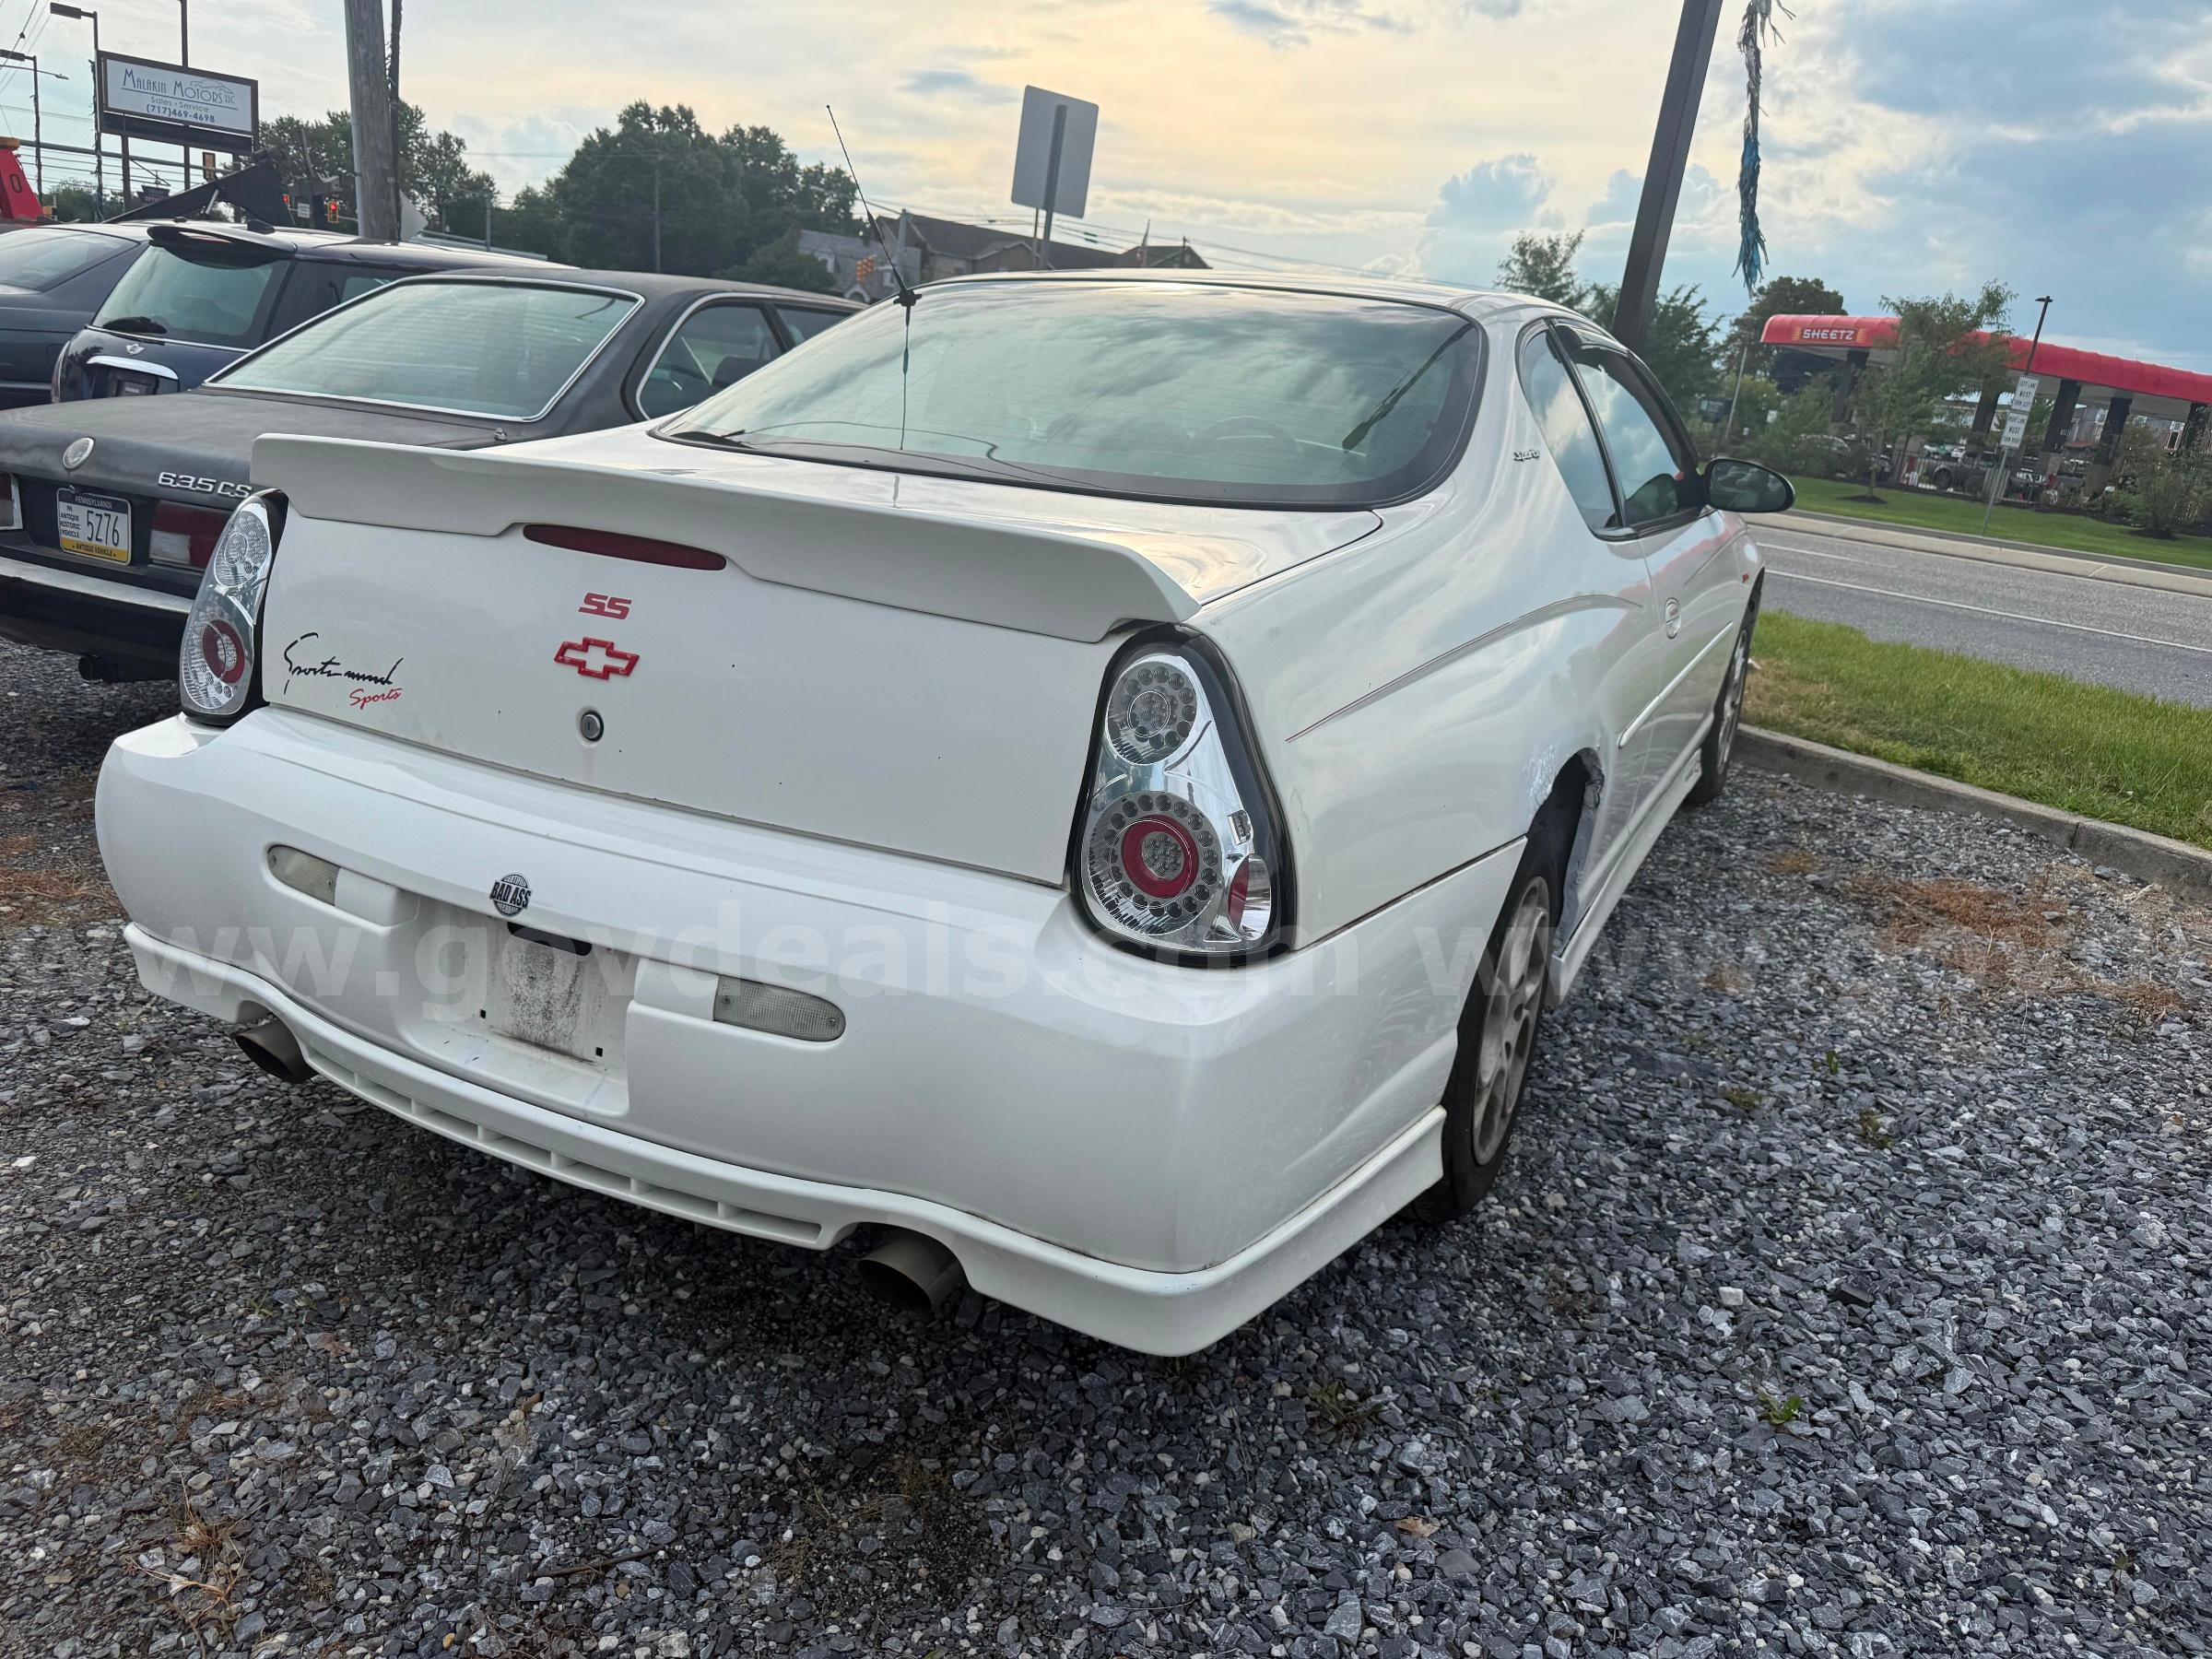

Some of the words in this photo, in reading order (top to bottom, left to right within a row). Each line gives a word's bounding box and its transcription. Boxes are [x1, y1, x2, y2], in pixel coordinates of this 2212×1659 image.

[173, 80, 222, 105] MOTORS
[150, 96, 172, 107] Sales
[179, 103, 209, 113] Service
[146, 104, 216, 124] (717)469-4698
[1803, 328, 1854, 341] SHEETZ
[75, 495, 113, 510] PENNSYLVANIA
[60, 512, 79, 522] ANTIQUE
[60, 521, 80, 530] HISTORIC
[61, 529, 79, 538] VEHICLE
[87, 510, 120, 547] 5Z76
[76, 542, 94, 553] ANTIQUE
[94, 546, 113, 558] VEHICLE
[578, 592, 632, 620] SS
[349, 688, 403, 710] Sports
[489, 881, 512, 903] BAD
[509, 887, 532, 909] ASS
